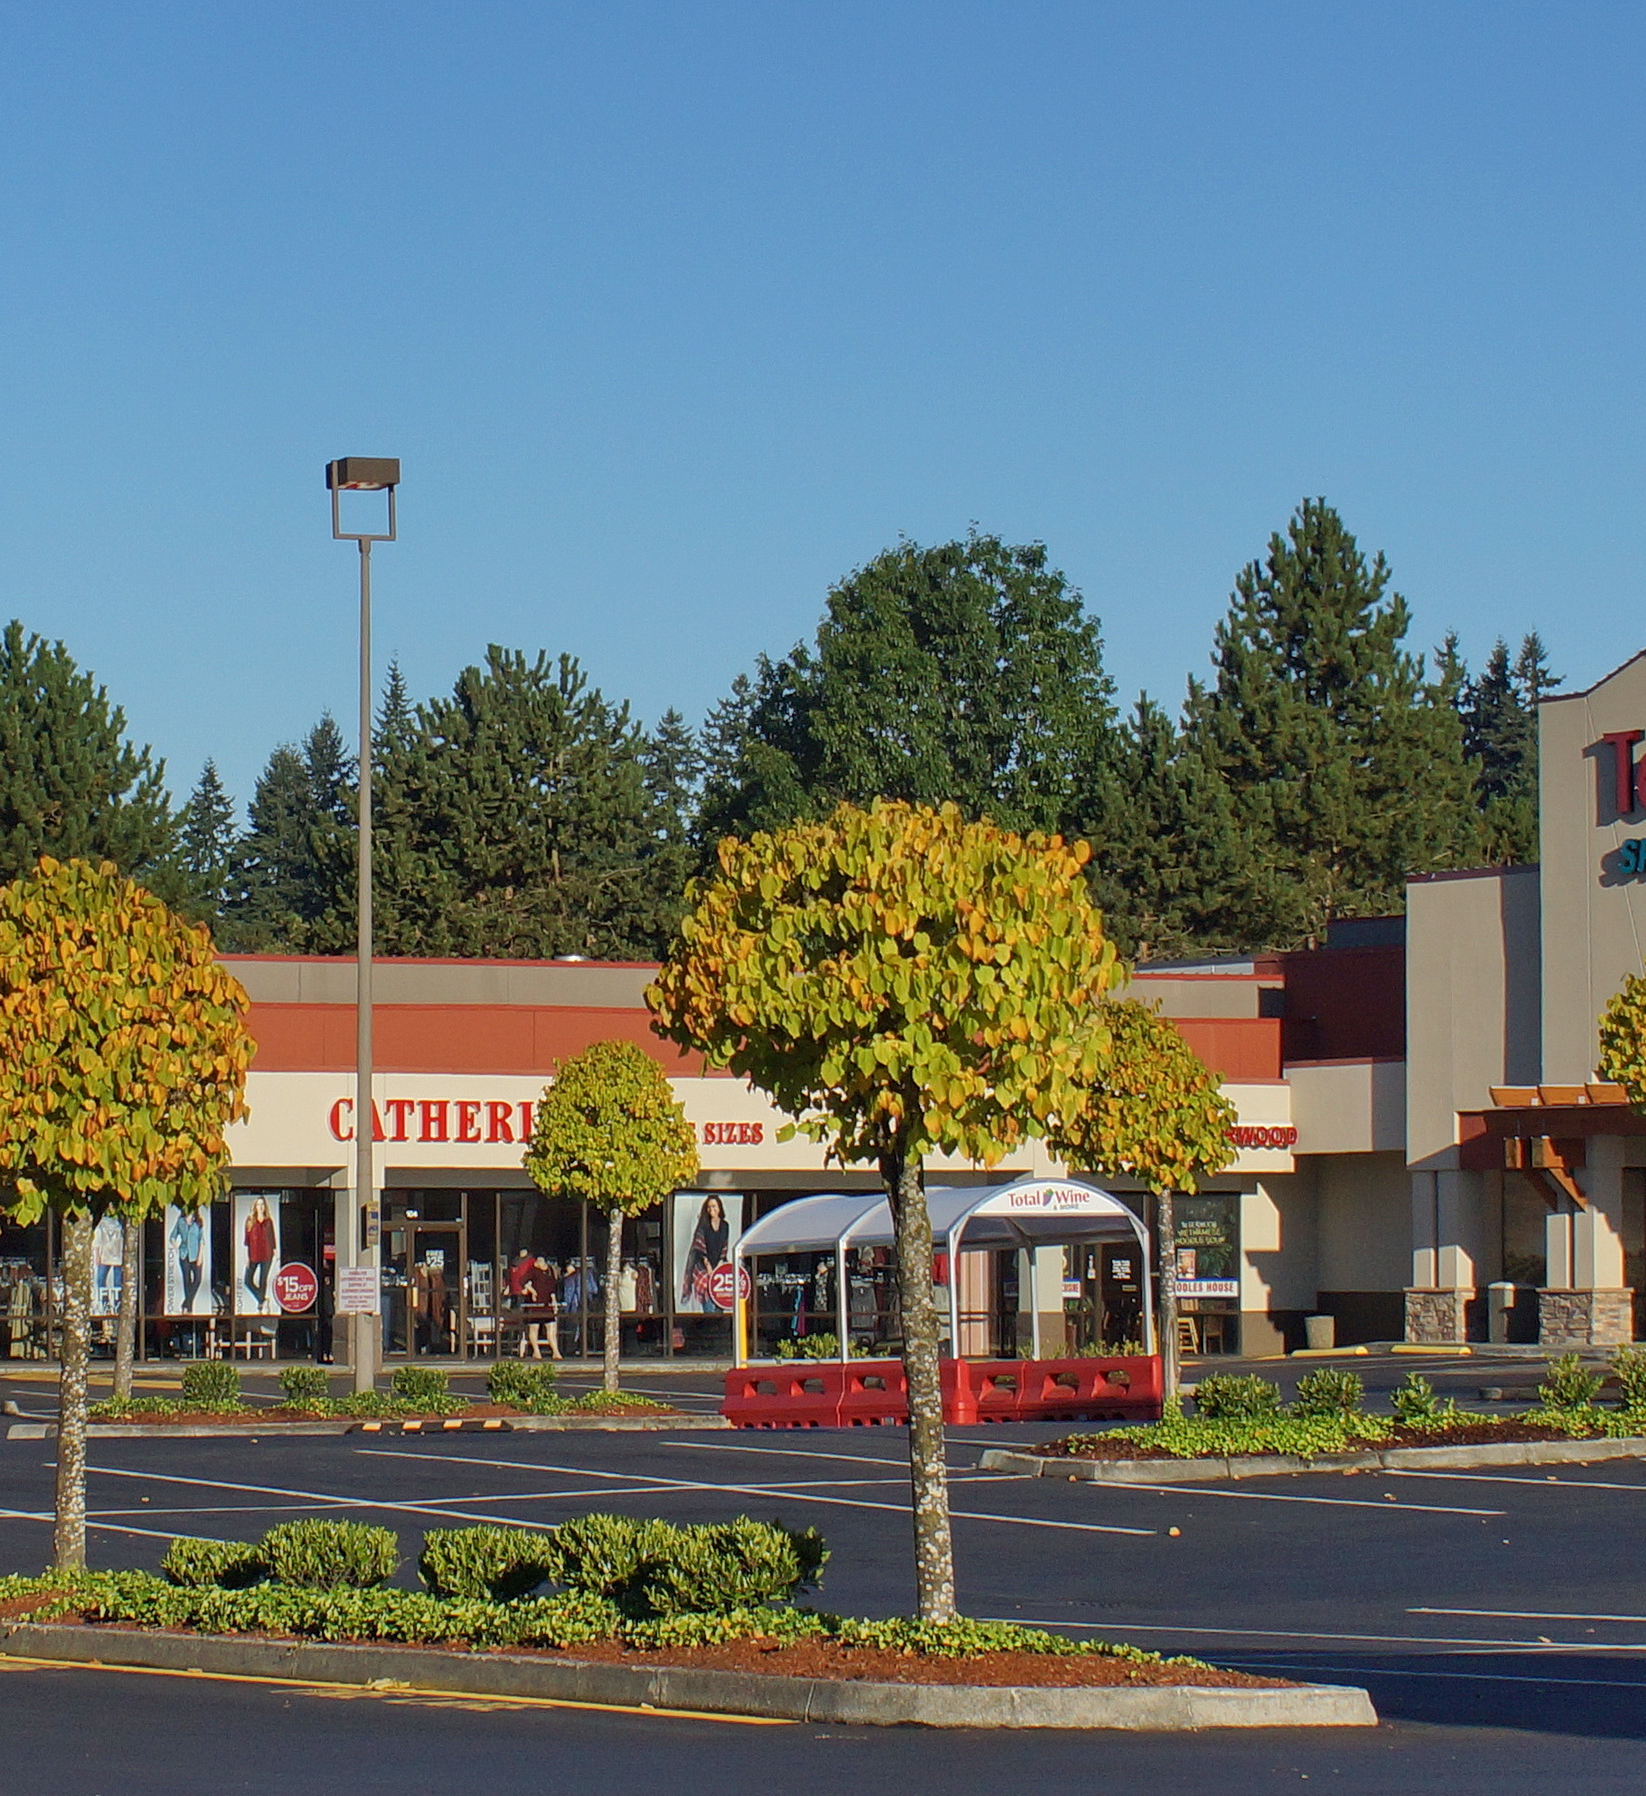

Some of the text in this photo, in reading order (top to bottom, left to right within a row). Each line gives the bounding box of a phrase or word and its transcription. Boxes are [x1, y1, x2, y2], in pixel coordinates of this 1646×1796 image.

[703, 1122, 765, 1145] SIZES
[1008, 1189, 1090, 1207] Total Wine
[276, 1275, 299, 1293] $15
[1206, 1282, 1234, 1293] HOUSE
[283, 1292, 309, 1301] JEANS
